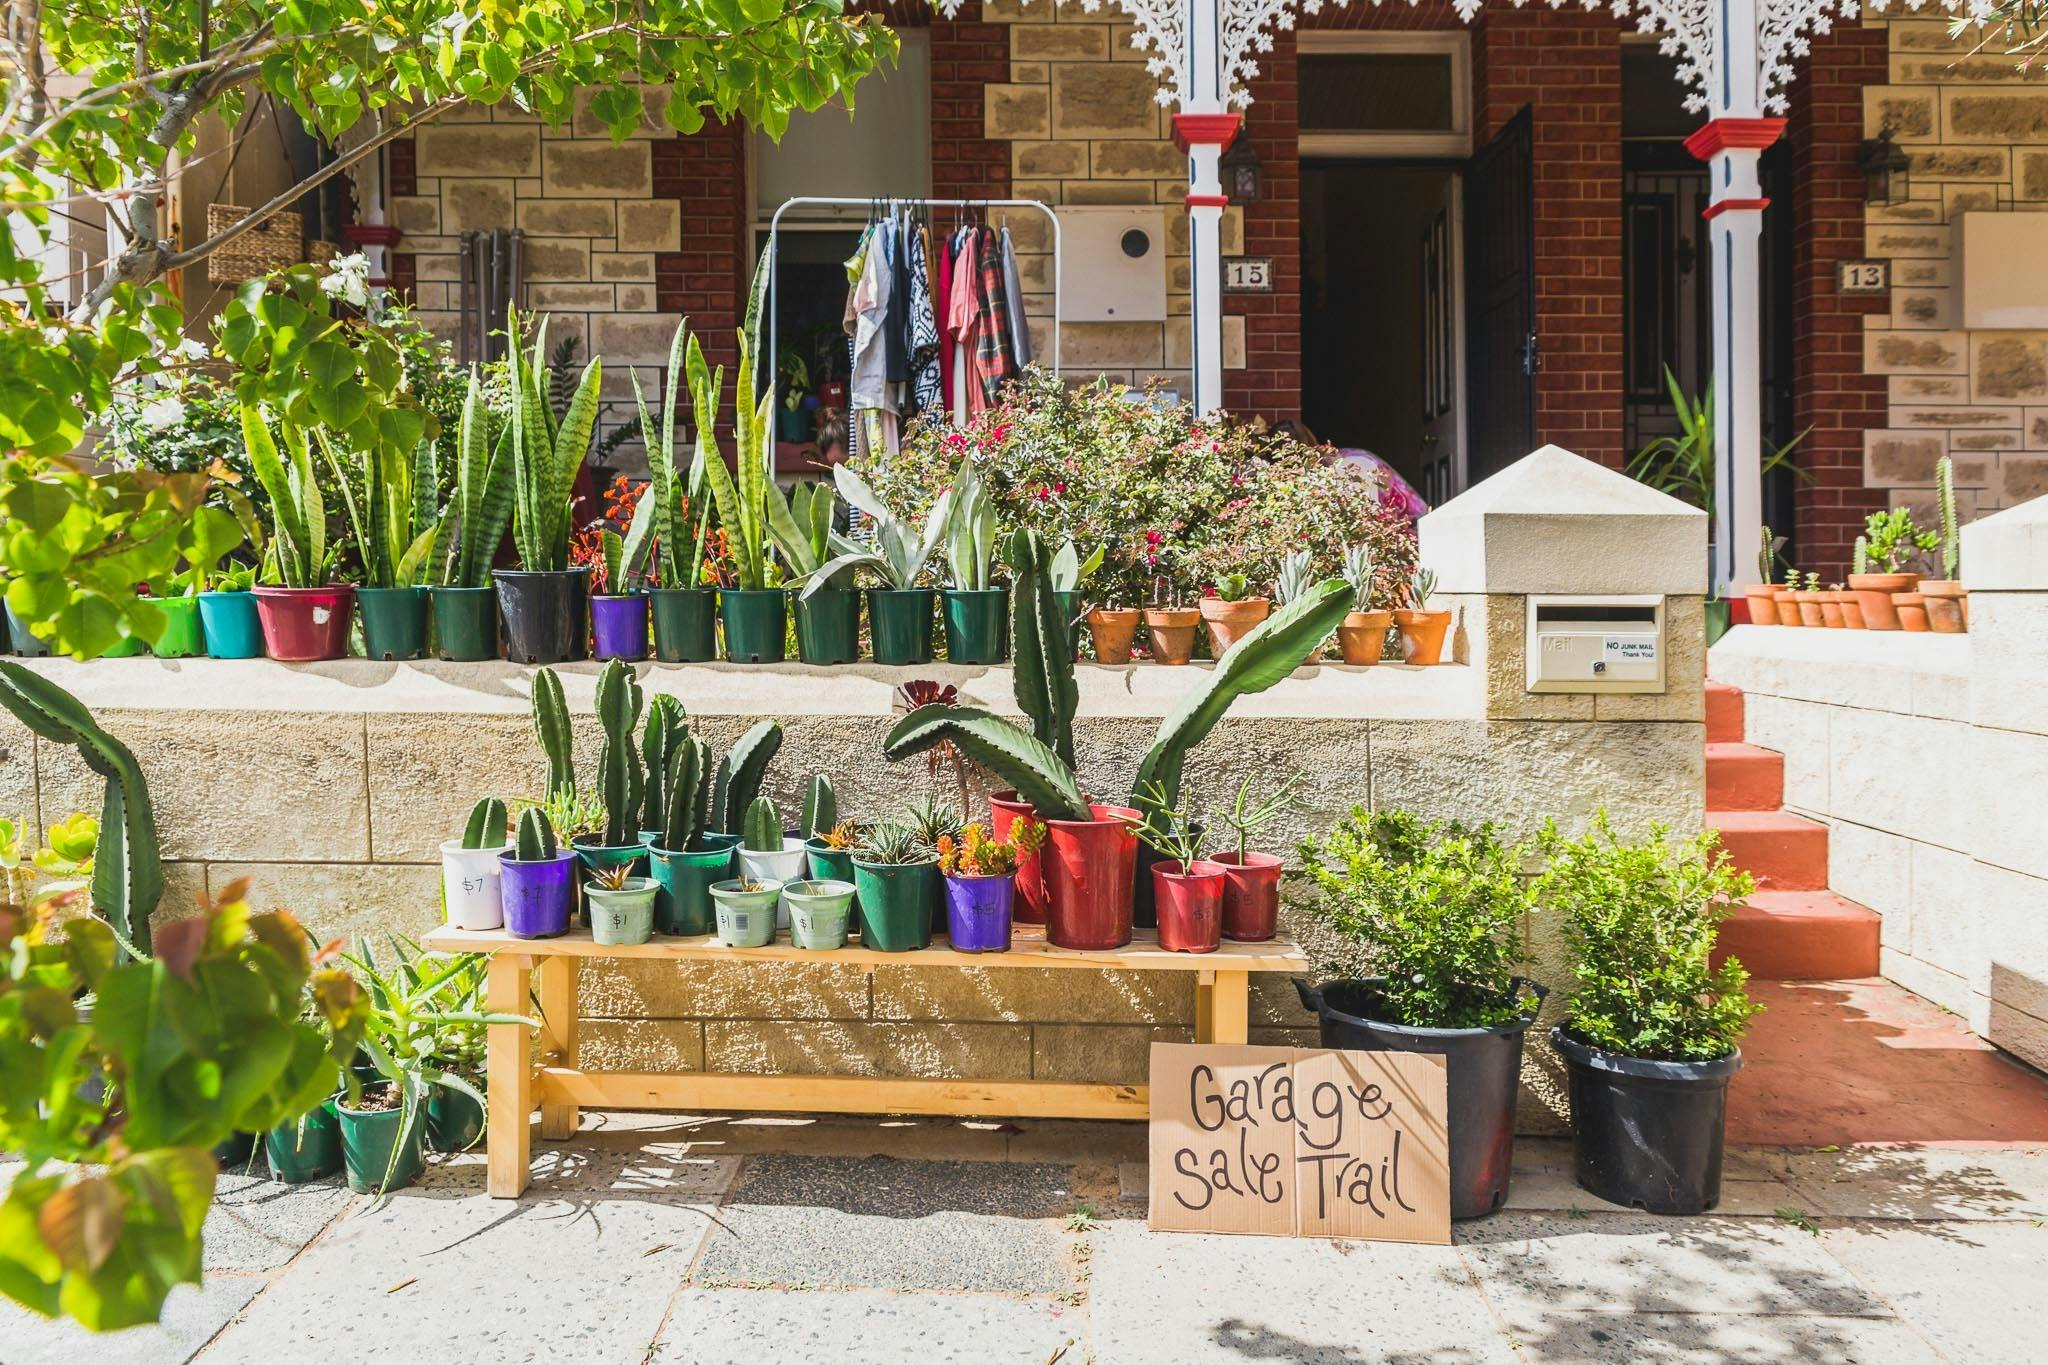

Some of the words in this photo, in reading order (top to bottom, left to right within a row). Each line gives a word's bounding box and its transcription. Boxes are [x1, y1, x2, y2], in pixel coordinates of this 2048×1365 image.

[1234, 265, 1263, 284] 15
[1850, 267, 1880, 286] 13
[1541, 636, 1575, 652] Mail
[1606, 641, 1619, 650] NO
[462, 877, 483, 895] $7
[612, 913, 628, 929] $1
[800, 915, 814, 932] $1
[1190, 1062, 1392, 1150] Garage
[1173, 1127, 1284, 1211] Sale
[1297, 1130, 1416, 1219] Trail
